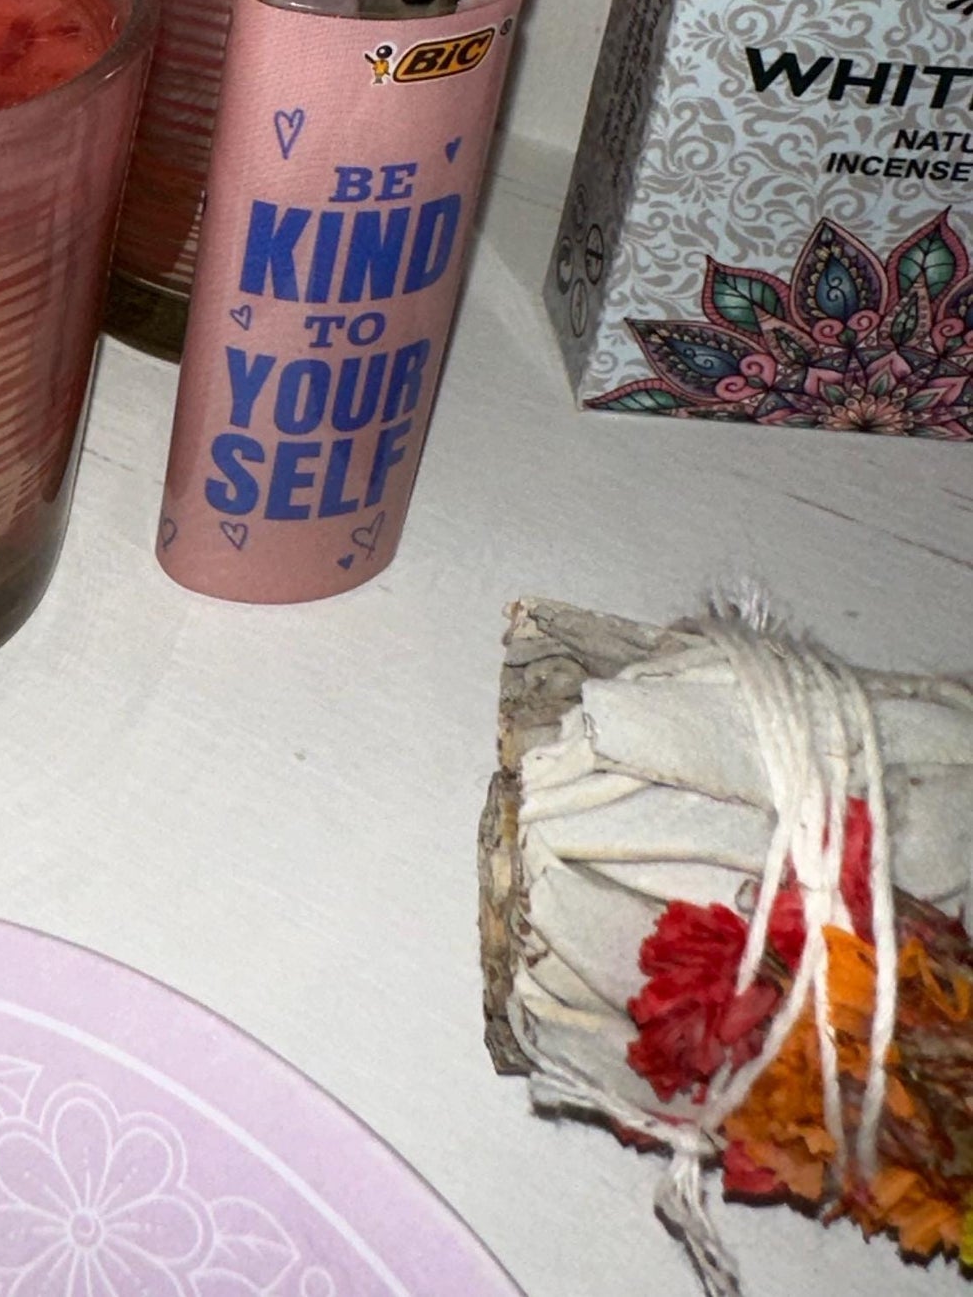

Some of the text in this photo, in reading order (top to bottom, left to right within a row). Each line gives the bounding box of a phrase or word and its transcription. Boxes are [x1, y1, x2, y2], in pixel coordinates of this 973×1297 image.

[745, 46, 973, 111] WHIT
[328, 162, 418, 203] BE
[825, 152, 973, 182] INCENSE
[238, 194, 461, 304] KIND
[305, 311, 387, 349] TO
[225, 339, 430, 436] YOUR
[205, 421, 412, 521] SELF
